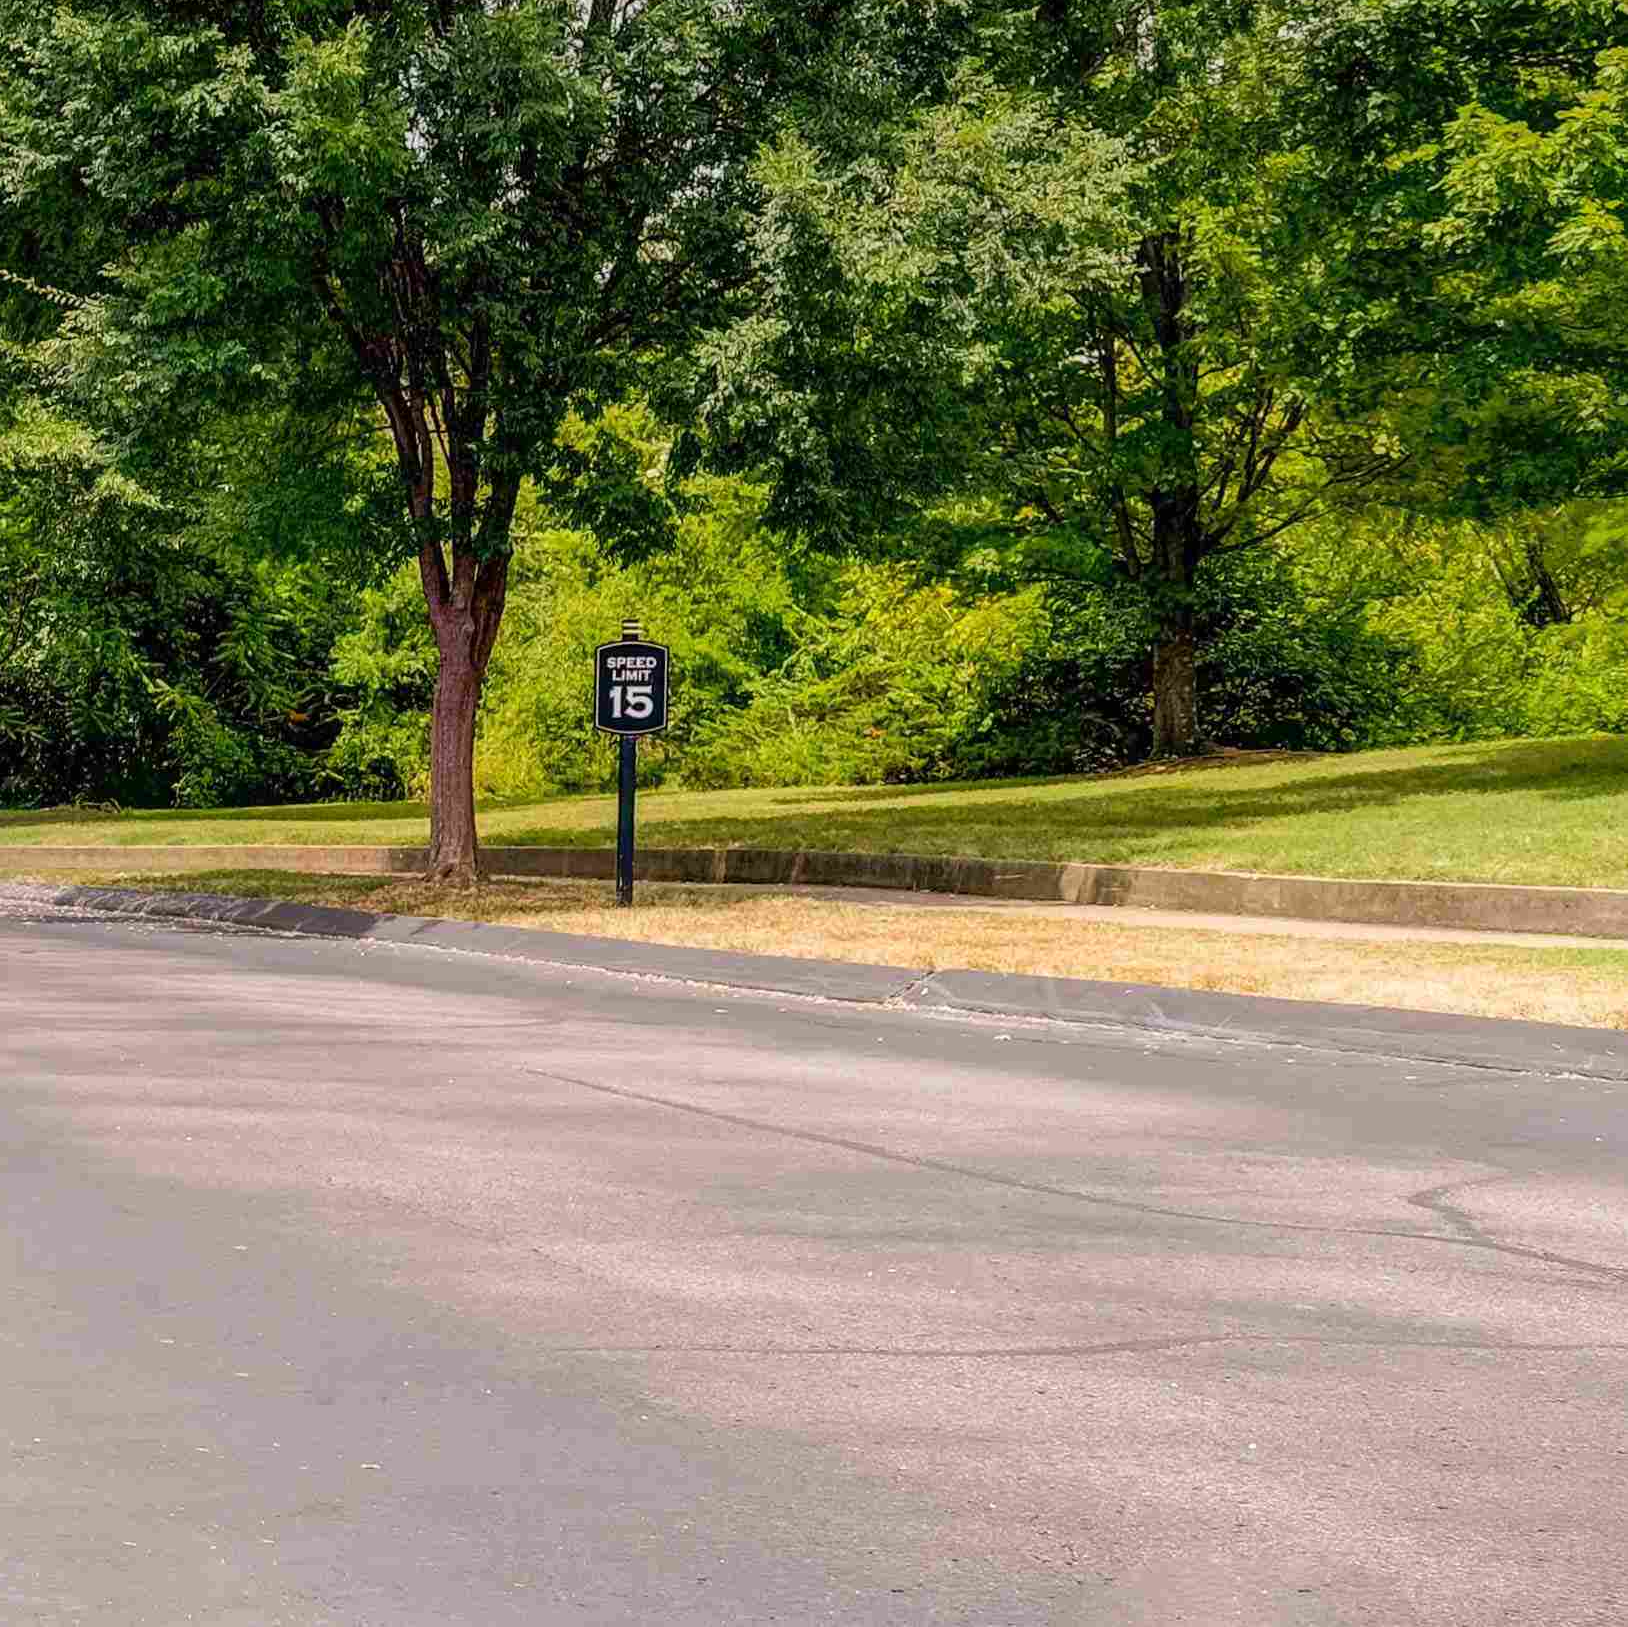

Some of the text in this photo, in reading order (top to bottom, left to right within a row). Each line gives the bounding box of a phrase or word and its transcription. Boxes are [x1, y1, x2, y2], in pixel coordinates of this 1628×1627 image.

[607, 657, 657, 669] SPEED
[612, 669, 652, 682] LIMIT
[609, 685, 654, 719] 15
